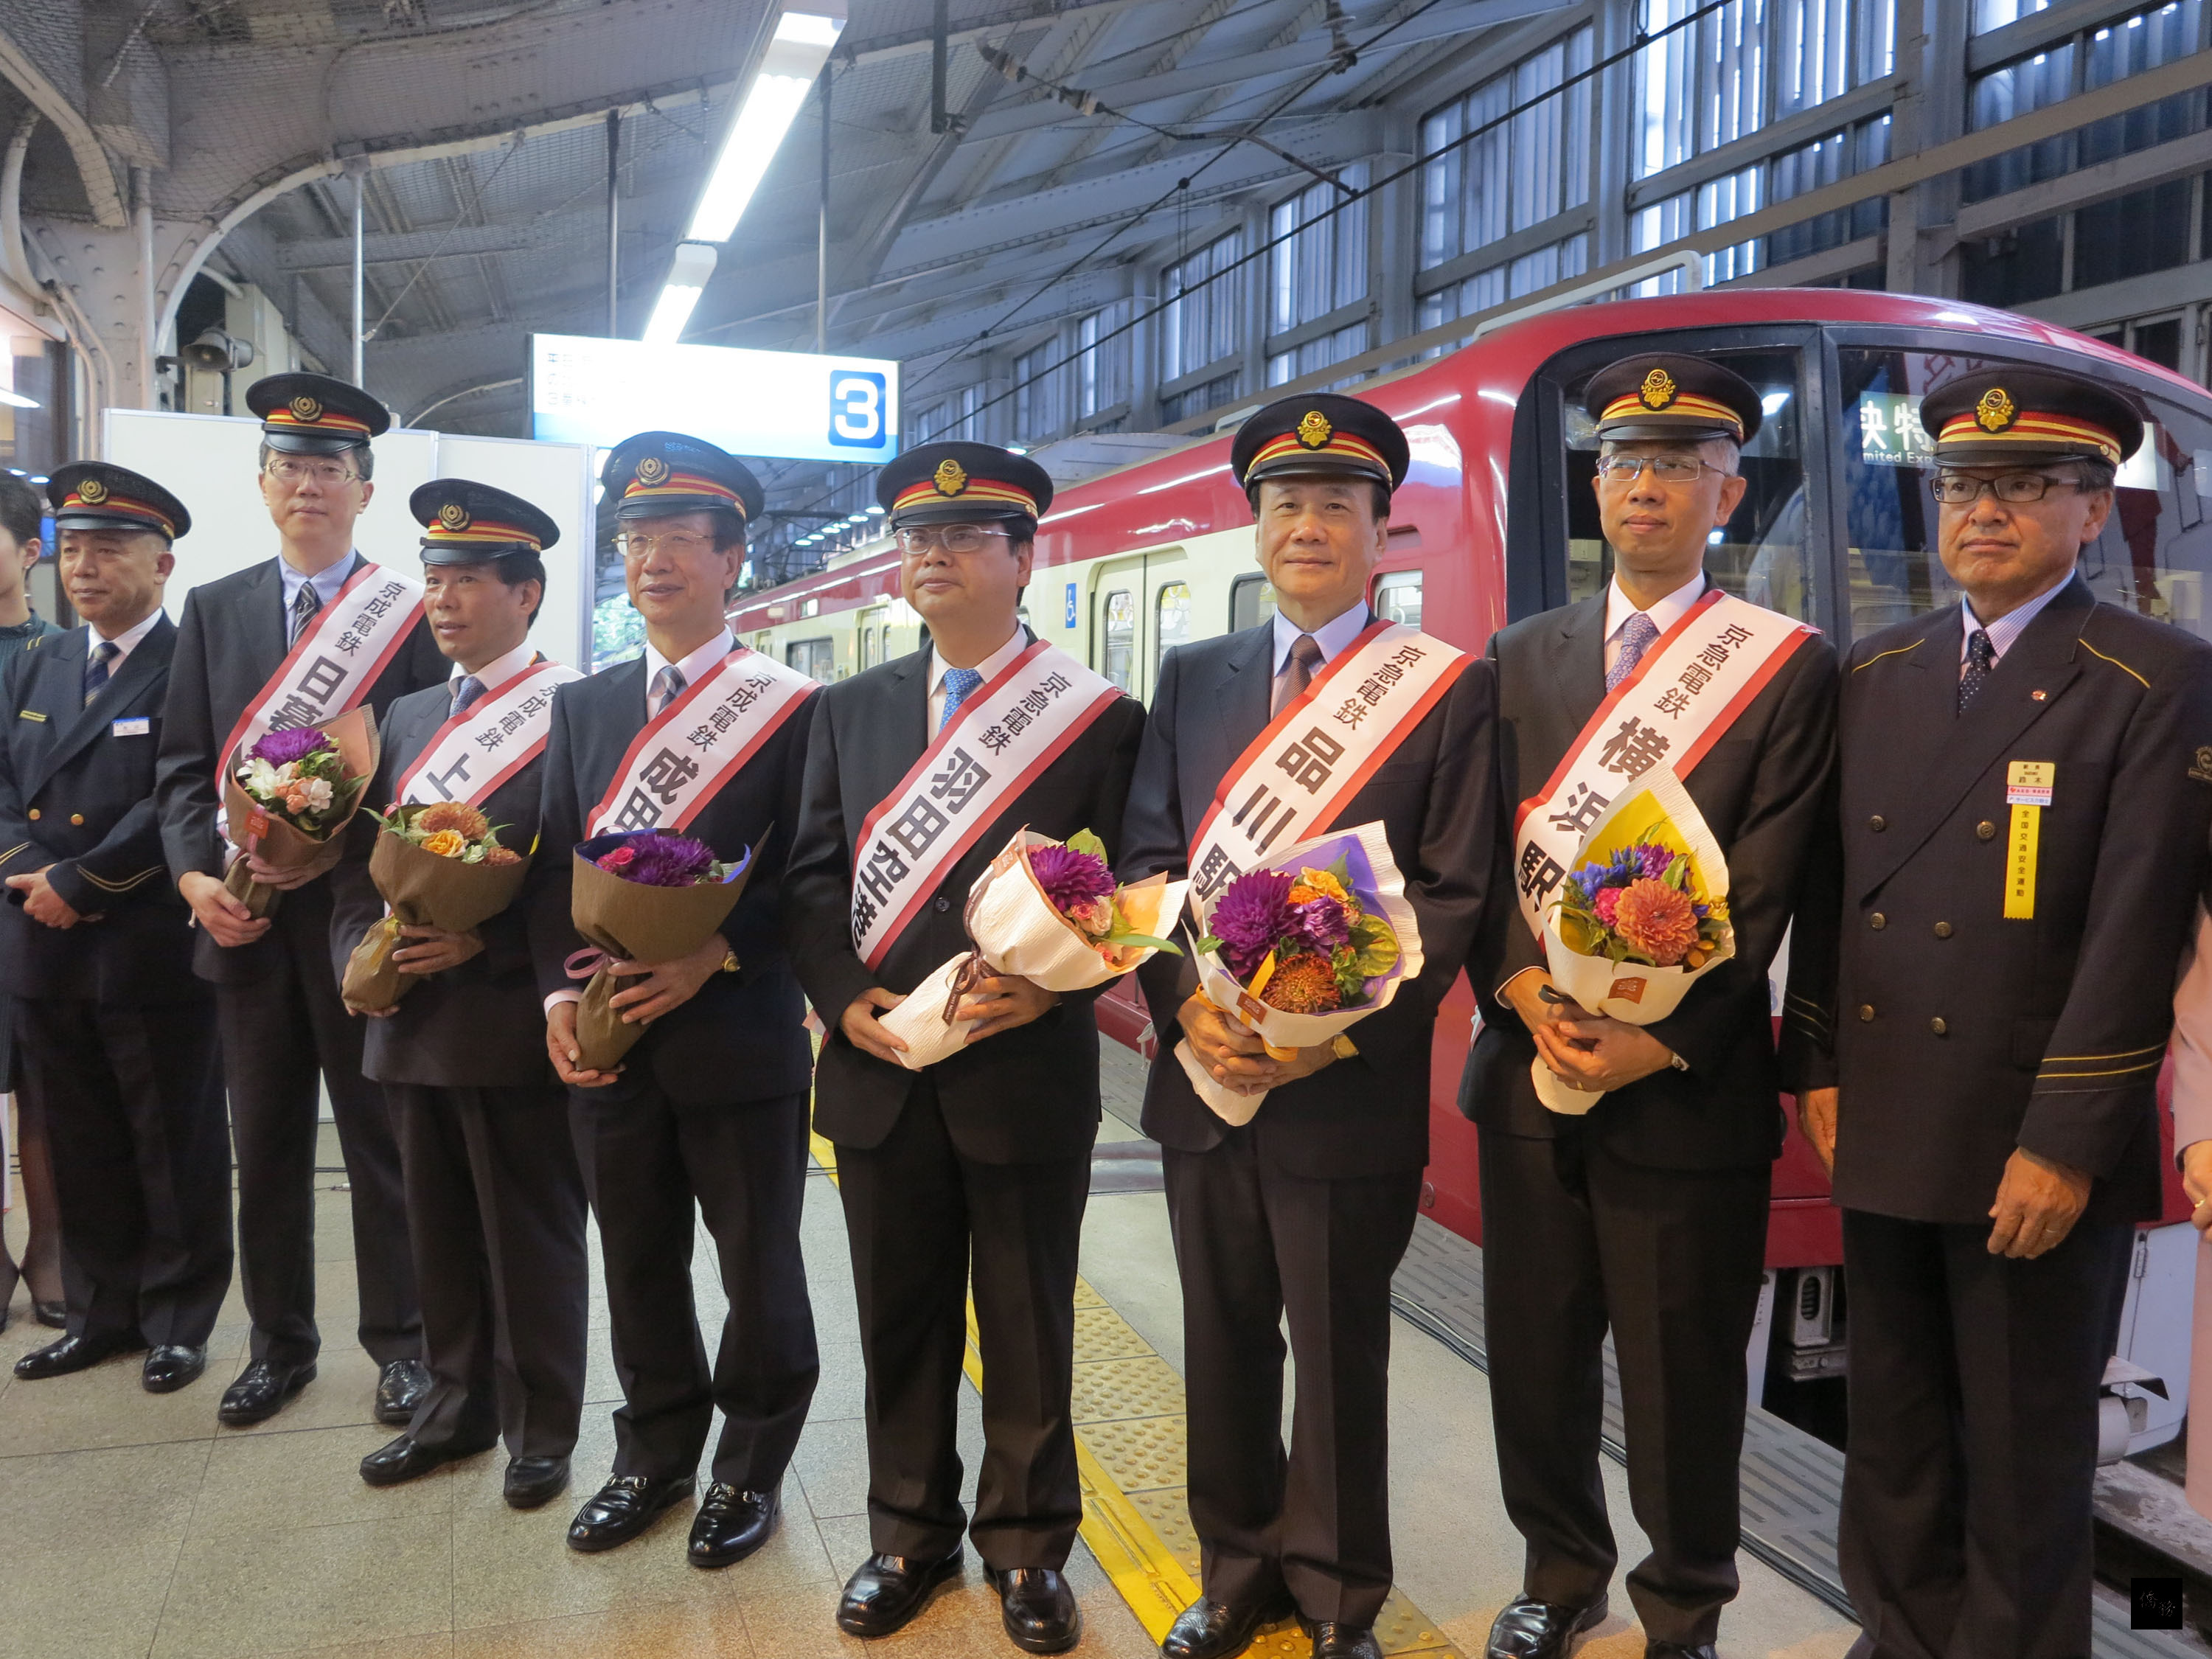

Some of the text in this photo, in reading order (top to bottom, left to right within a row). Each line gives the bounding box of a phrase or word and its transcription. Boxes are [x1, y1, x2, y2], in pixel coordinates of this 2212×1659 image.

[835, 378, 879, 439] 3
[335, 580, 407, 657] 京成電鉄
[406, 752, 471, 804] 上
[613, 671, 777, 832] 京成電鉄 成田
[851, 671, 1073, 950] 京急電鉄 羽田空港
[1193, 644, 1427, 902] 京急電鉄 品川駅
[1517, 623, 1754, 913] 京急電鉄 横浜駅
[2015, 810, 2030, 897] 全国交通安全運動
